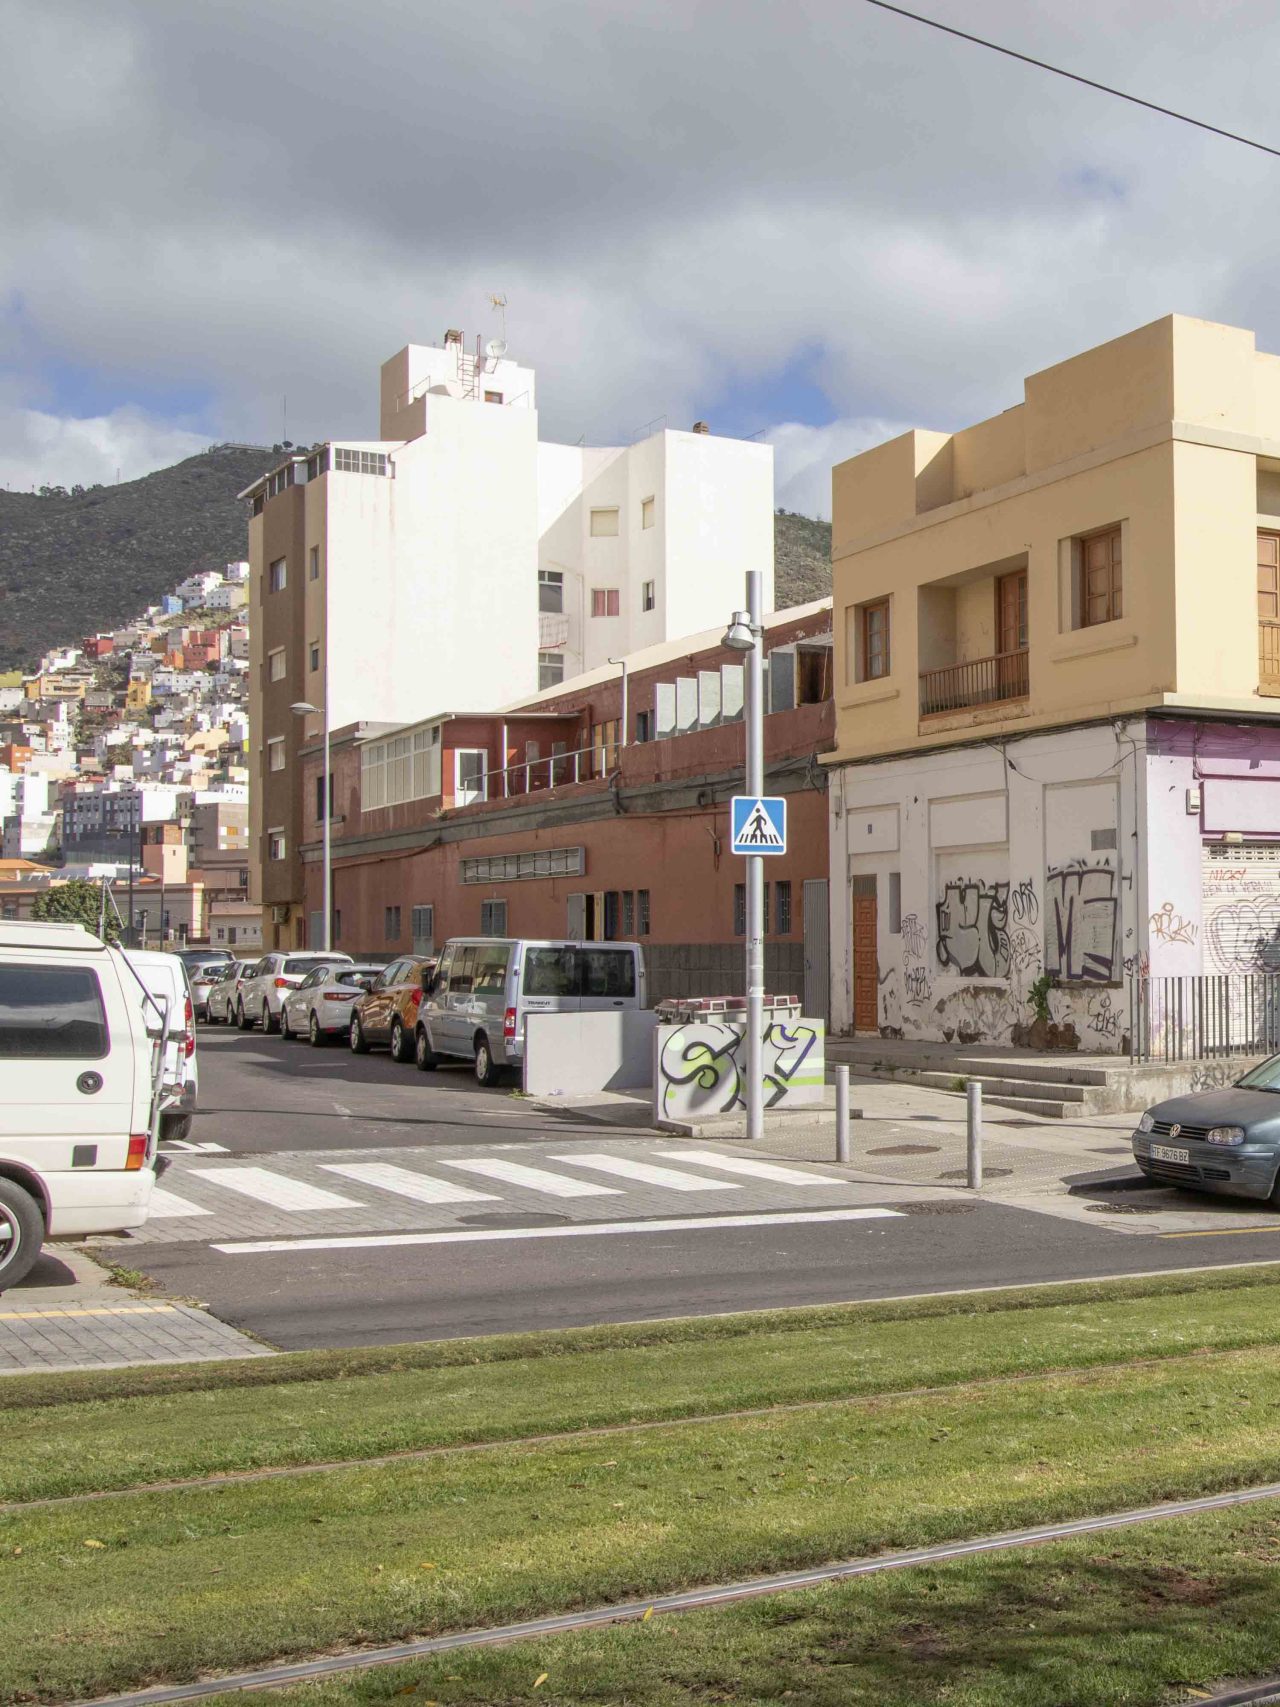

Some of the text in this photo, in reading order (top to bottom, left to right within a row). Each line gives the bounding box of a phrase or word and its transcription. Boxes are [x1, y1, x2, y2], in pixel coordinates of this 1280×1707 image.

[1153, 1147, 1188, 1163] TF 9676 BZ
